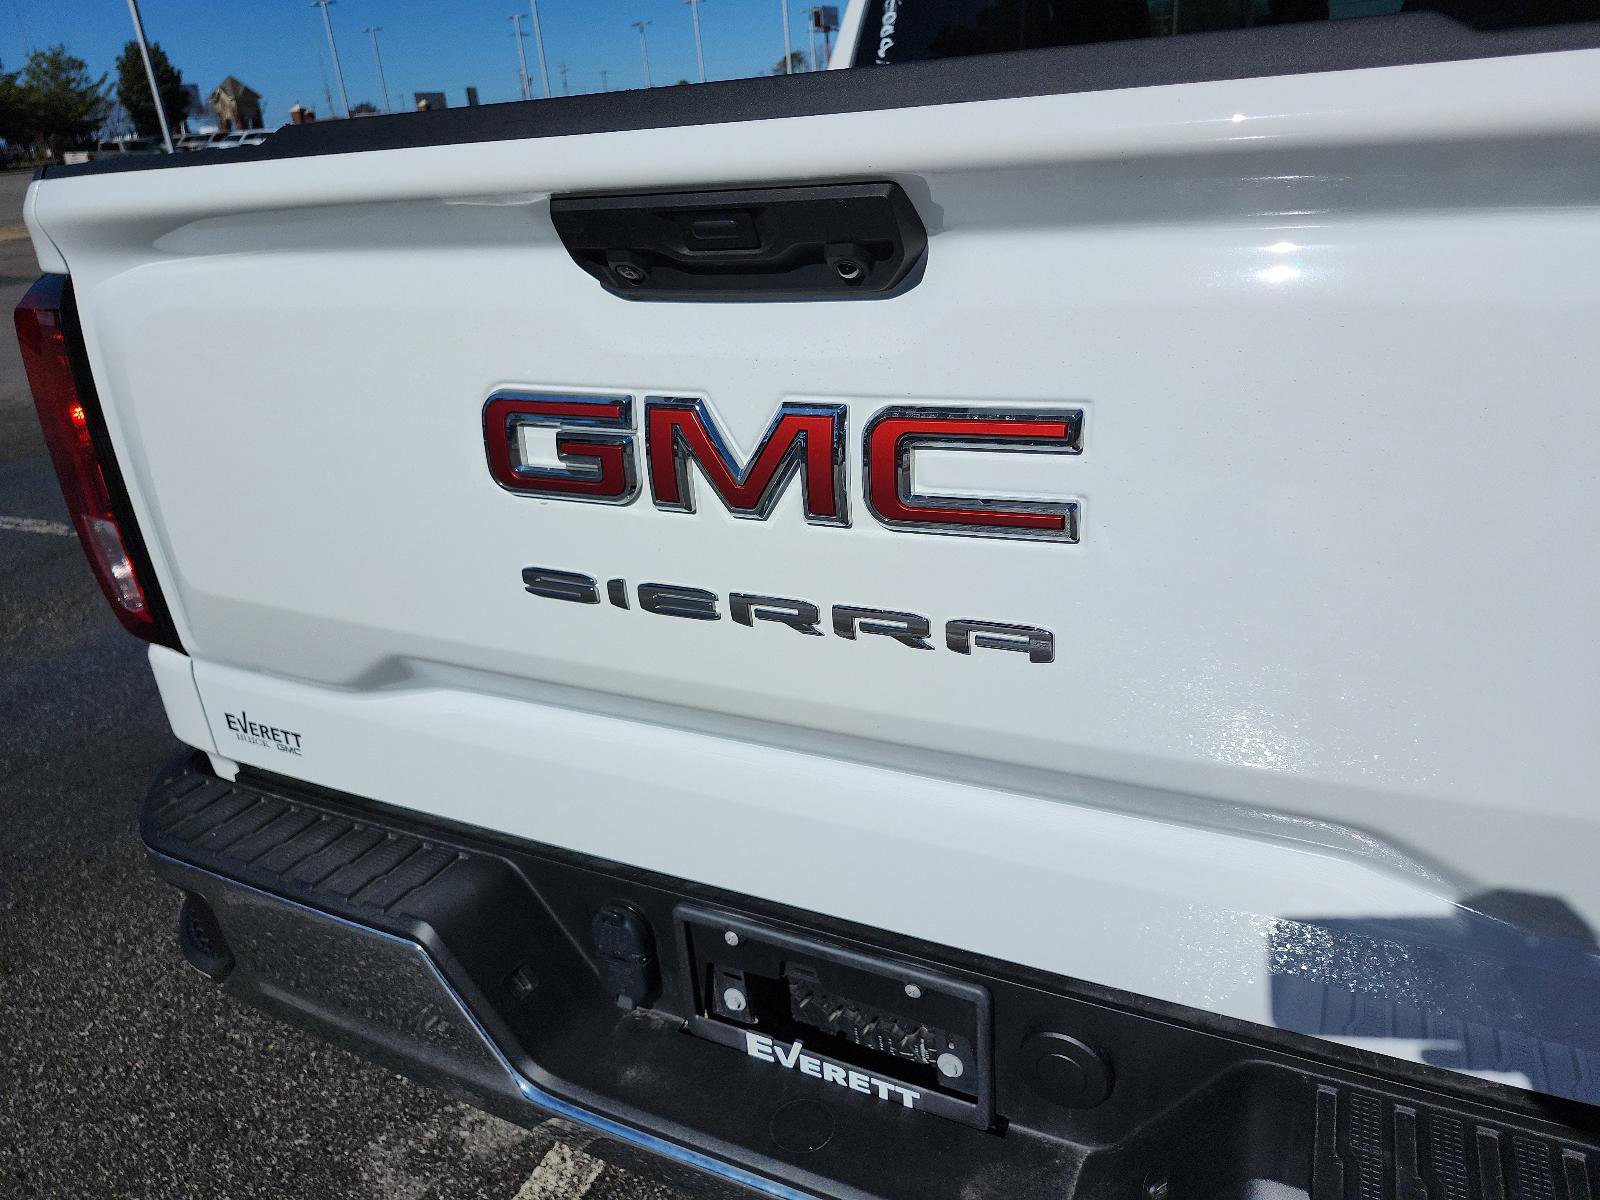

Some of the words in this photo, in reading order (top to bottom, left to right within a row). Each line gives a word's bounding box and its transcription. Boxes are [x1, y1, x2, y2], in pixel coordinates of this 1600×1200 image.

[482, 388, 1084, 544] GMC
[521, 566, 1056, 664] SIERRA
[224, 710, 302, 748] EVERETT
[276, 743, 303, 757] GMC
[745, 1031, 921, 1109] EVERETT
